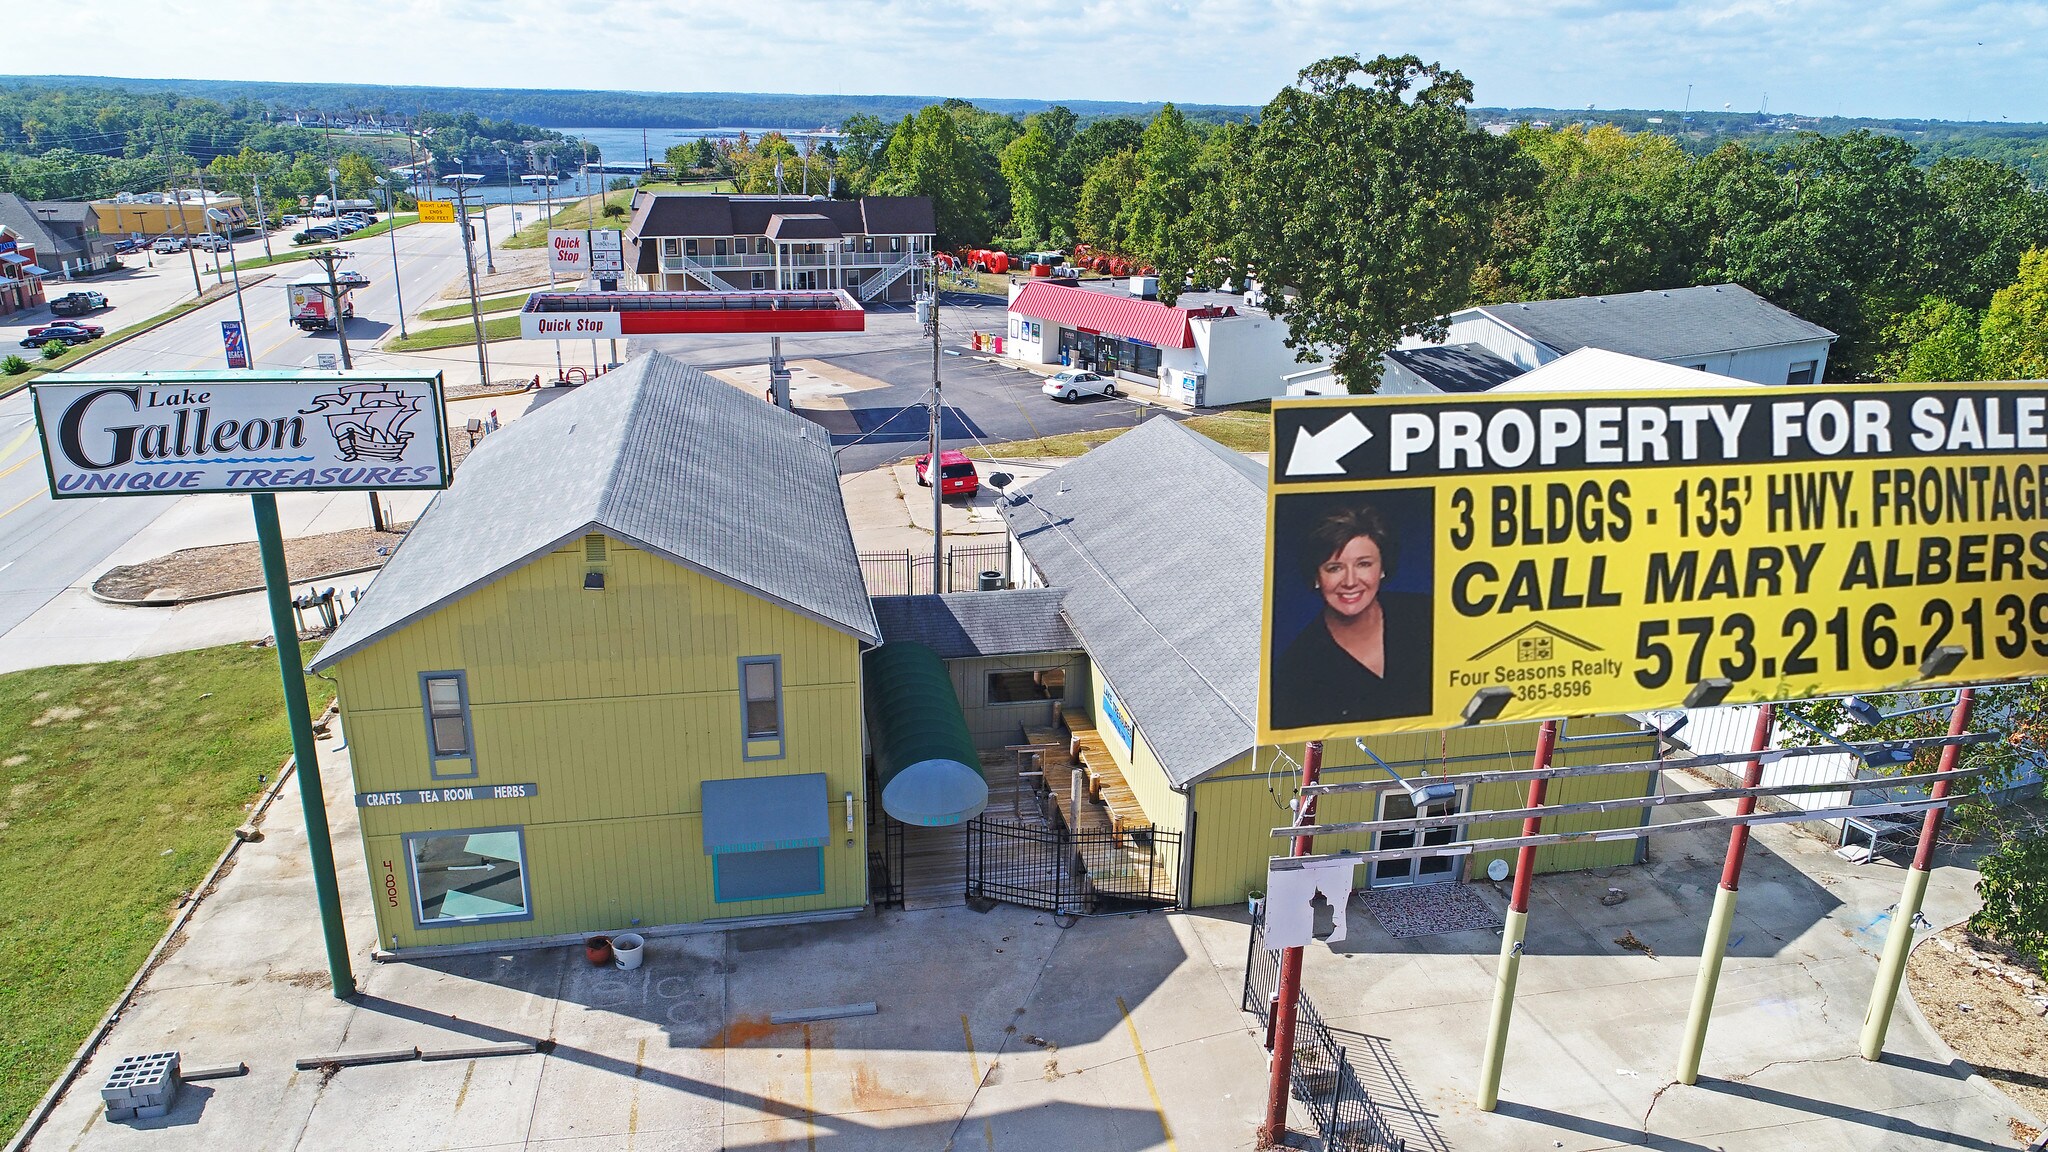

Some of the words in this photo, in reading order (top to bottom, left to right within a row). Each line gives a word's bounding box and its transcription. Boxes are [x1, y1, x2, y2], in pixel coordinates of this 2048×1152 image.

[554, 236, 580, 250] Quick
[557, 249, 579, 263] Stop
[538, 318, 571, 333] Quick
[576, 318, 604, 333] Stop
[228, 351, 244, 359] OSAGE
[149, 389, 211, 408] Lake
[57, 386, 306, 470] Galleon
[1390, 404, 1752, 472] PROPERTY
[1773, 398, 1892, 457] FOR
[1911, 396, 2048, 451] SALE
[57, 471, 205, 490] UNIQUE
[226, 465, 436, 486] TREASURES
[1449, 487, 1475, 551] 3
[1491, 481, 1632, 547] BLDGS
[1673, 477, 1752, 539] 135'
[1768, 470, 1858, 532] HWY.
[1872, 463, 2048, 527] FRONTAGE
[1451, 556, 1622, 617] CALL
[1644, 543, 1826, 605] MARY
[1839, 531, 2048, 591] ALBERS
[1633, 593, 2048, 689] 573.216.2139
[1450, 669, 1490, 687] Four
[1494, 664, 1567, 683] Seasons
[1572, 658, 1623, 679] Realty
[367, 794, 402, 806] CRAFTS
[419, 791, 439, 803] TEA
[444, 788, 474, 801] ROOM
[494, 785, 525, 799] HERBS
[383, 860, 398, 907] 4805
